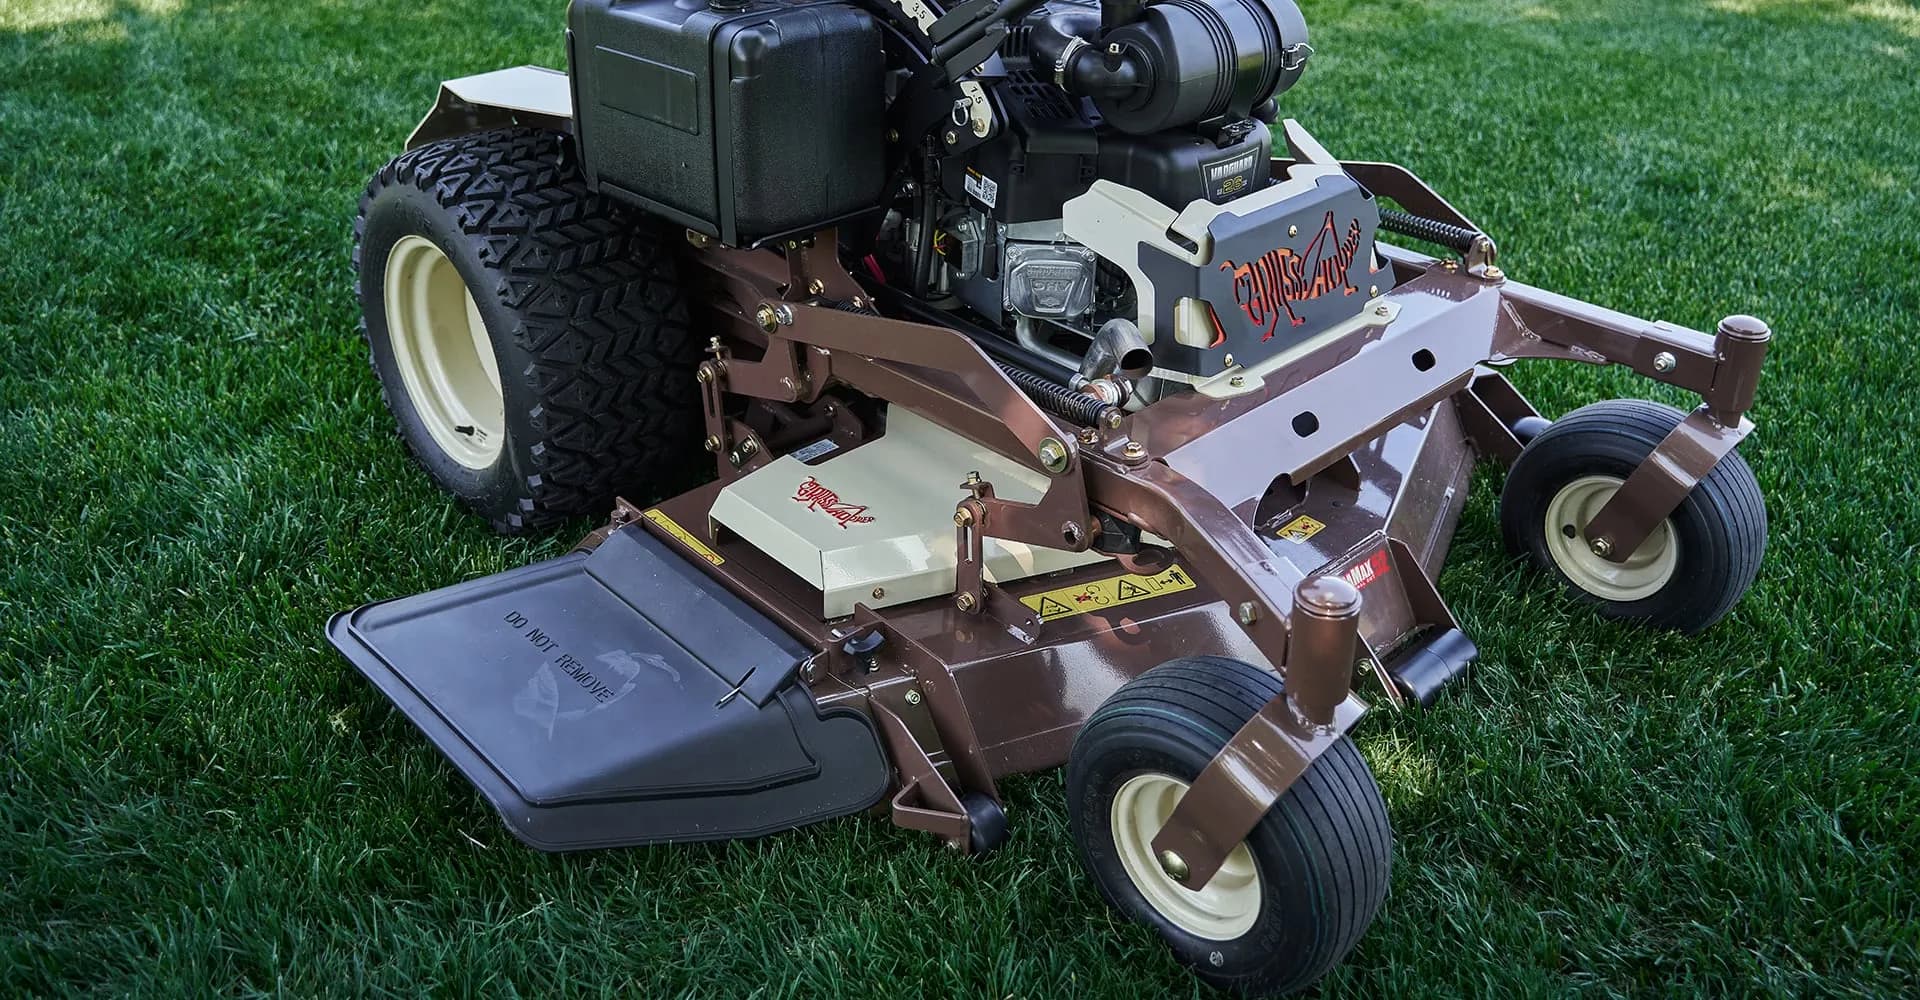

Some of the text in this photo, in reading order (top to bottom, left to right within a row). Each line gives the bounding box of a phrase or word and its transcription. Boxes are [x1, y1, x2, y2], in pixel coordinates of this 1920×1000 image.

[912, 3, 928, 20] 3.5
[970, 86, 984, 104] 1.5
[1210, 155, 1254, 182] VANGUARD
[1222, 175, 1243, 195] 26
[503, 610, 615, 703] DO NOT REMOVE
